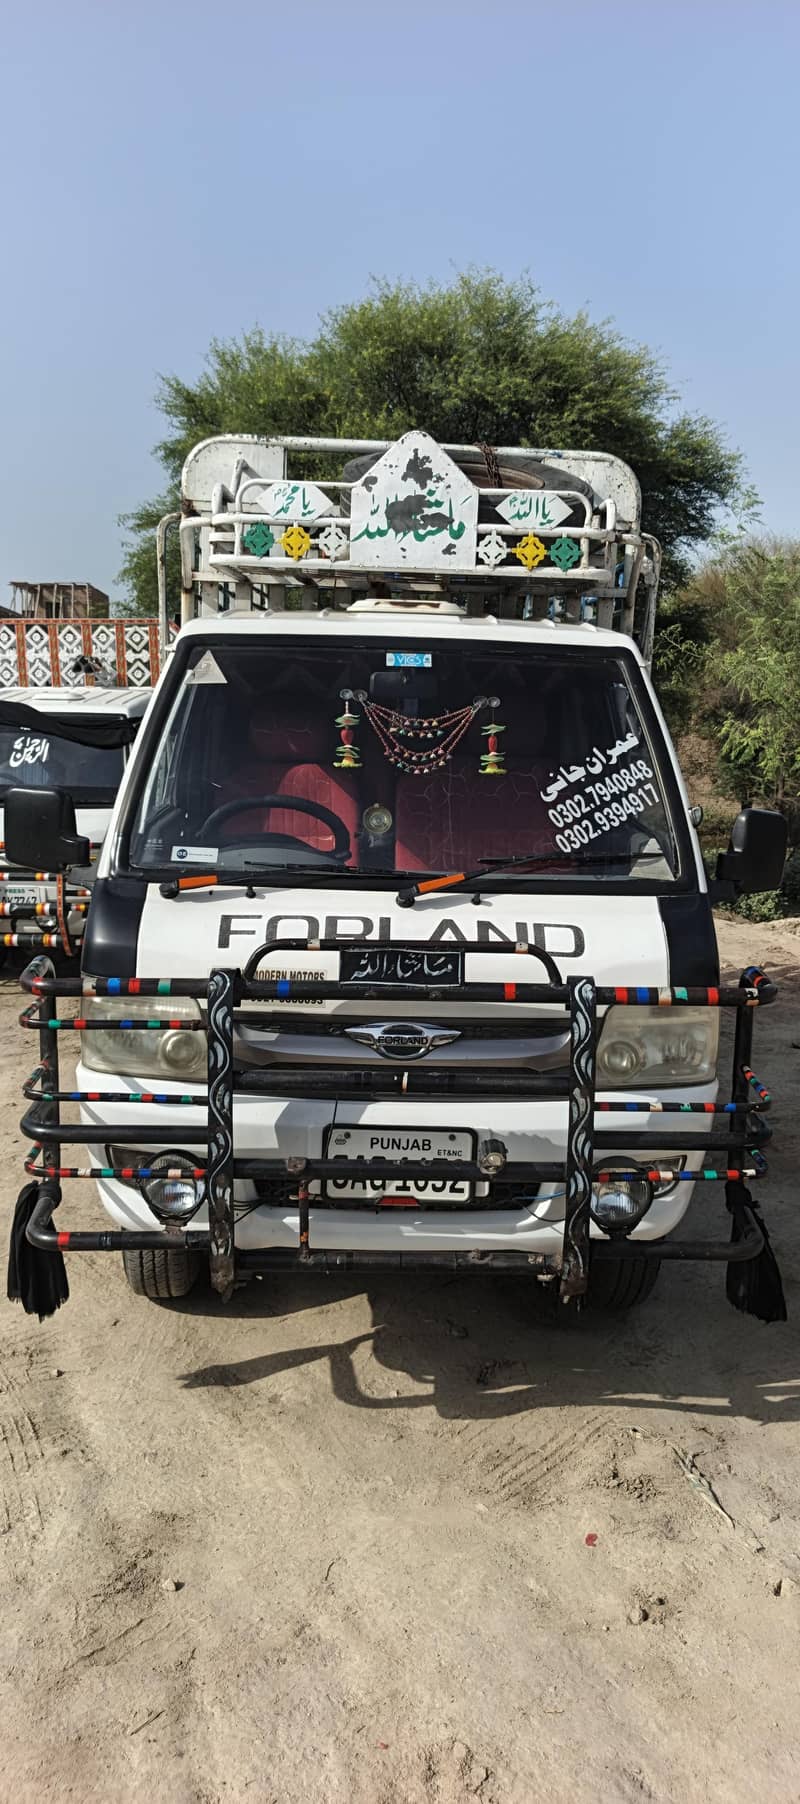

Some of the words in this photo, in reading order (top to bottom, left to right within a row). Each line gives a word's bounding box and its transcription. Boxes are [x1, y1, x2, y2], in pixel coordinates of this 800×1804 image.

[548, 759, 654, 828] 0302.7940848
[555, 783, 660, 853] 0302.9394917
[217, 914, 586, 958] FORLAND
[378, 1035, 428, 1045] FORLAND
[370, 1137, 432, 1151] PUNJAB
[437, 1149, 463, 1157] ET&NC
